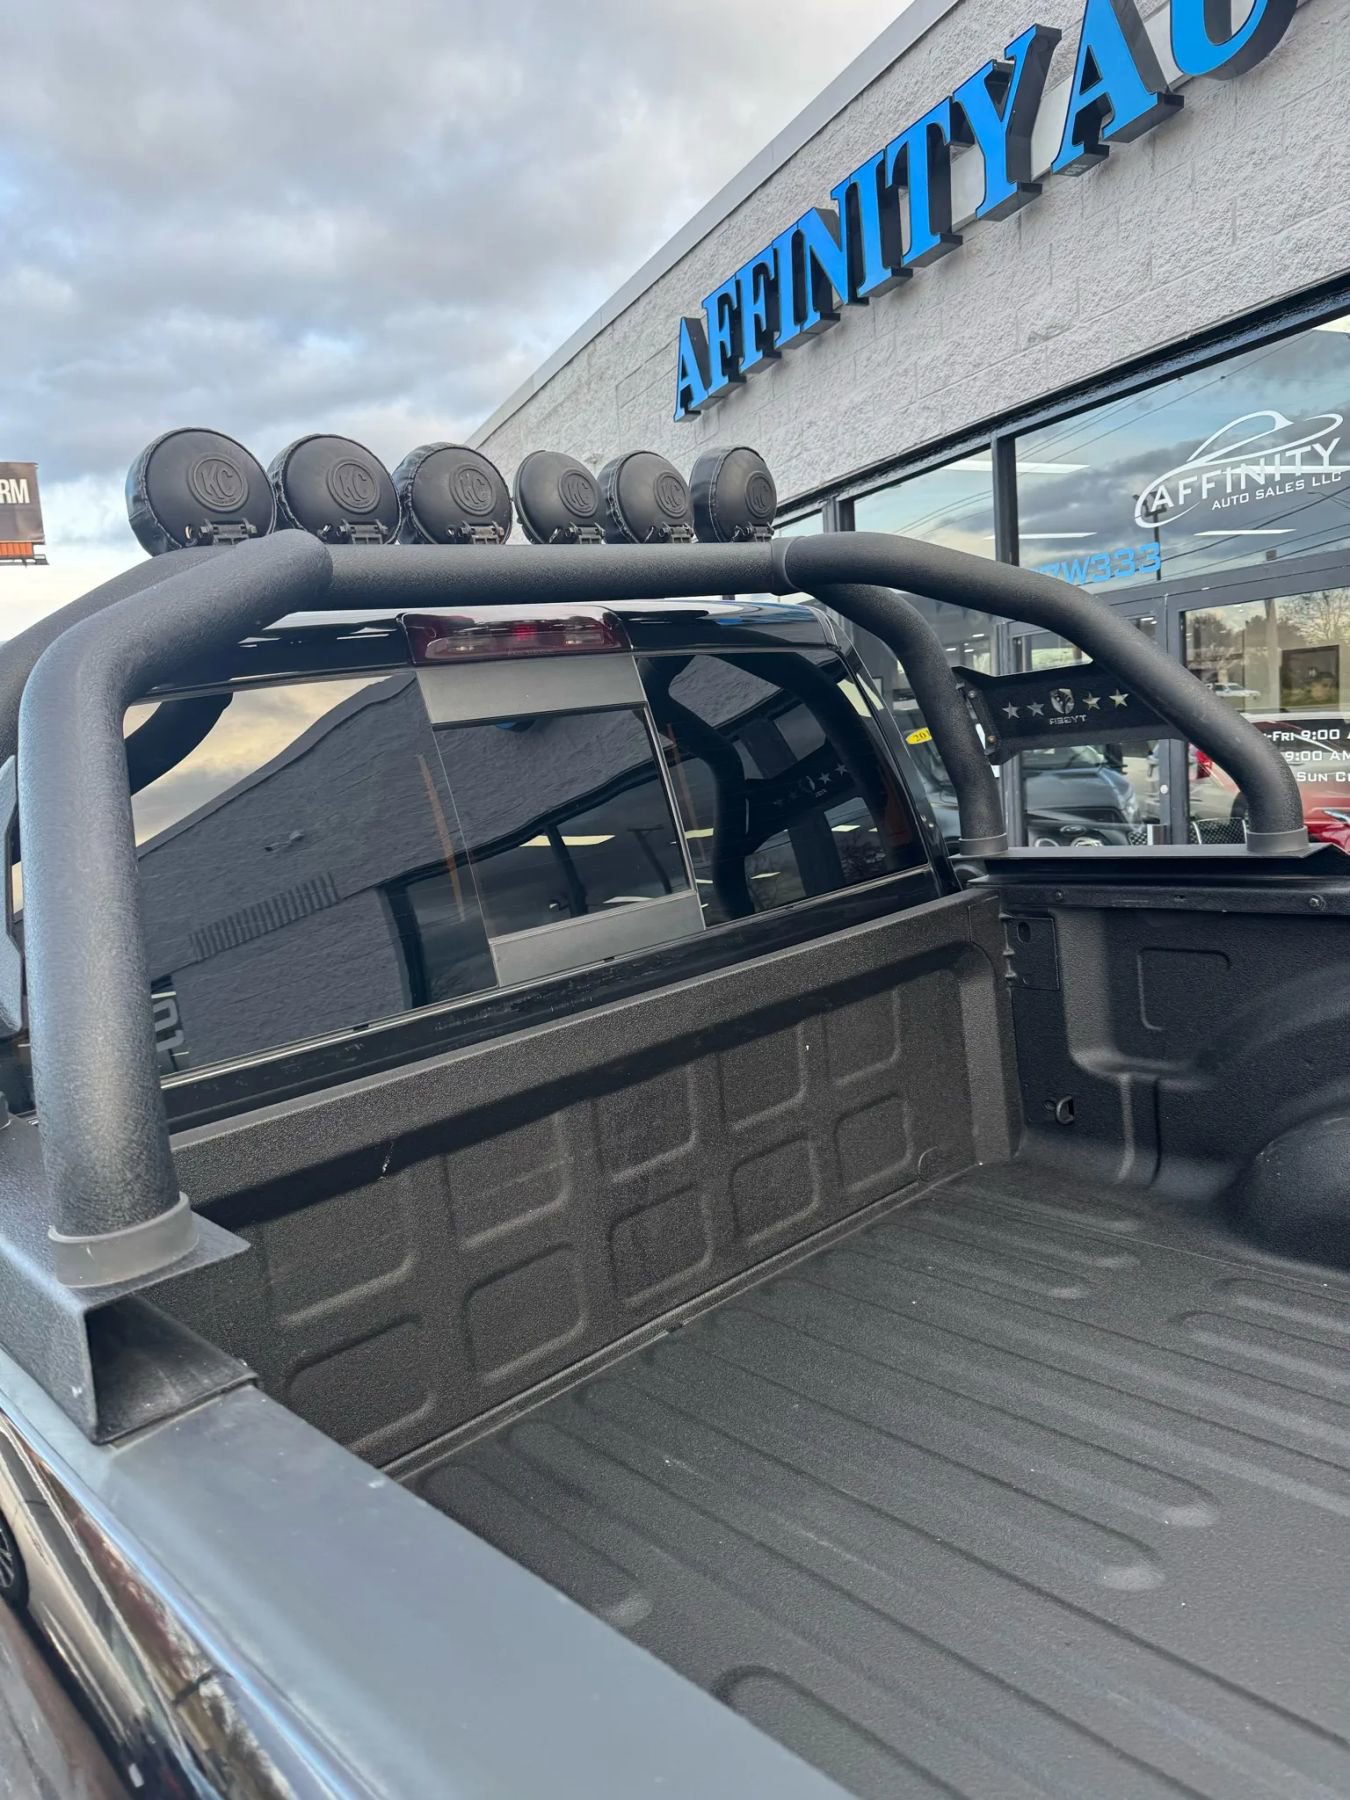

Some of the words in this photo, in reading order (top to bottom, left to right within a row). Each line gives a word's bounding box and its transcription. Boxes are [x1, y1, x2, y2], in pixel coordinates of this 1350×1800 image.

[673, 23, 1058, 422] AFFINITY
[1151, 437, 1341, 512] AFFINITY
[1212, 493, 1249, 511] AUTO
[1255, 479, 1305, 500] SALES
[1312, 471, 1341, 488] LLC
[1300, 728, 1340, 741] 9:00
[1285, 750, 1323, 762] 9:00
